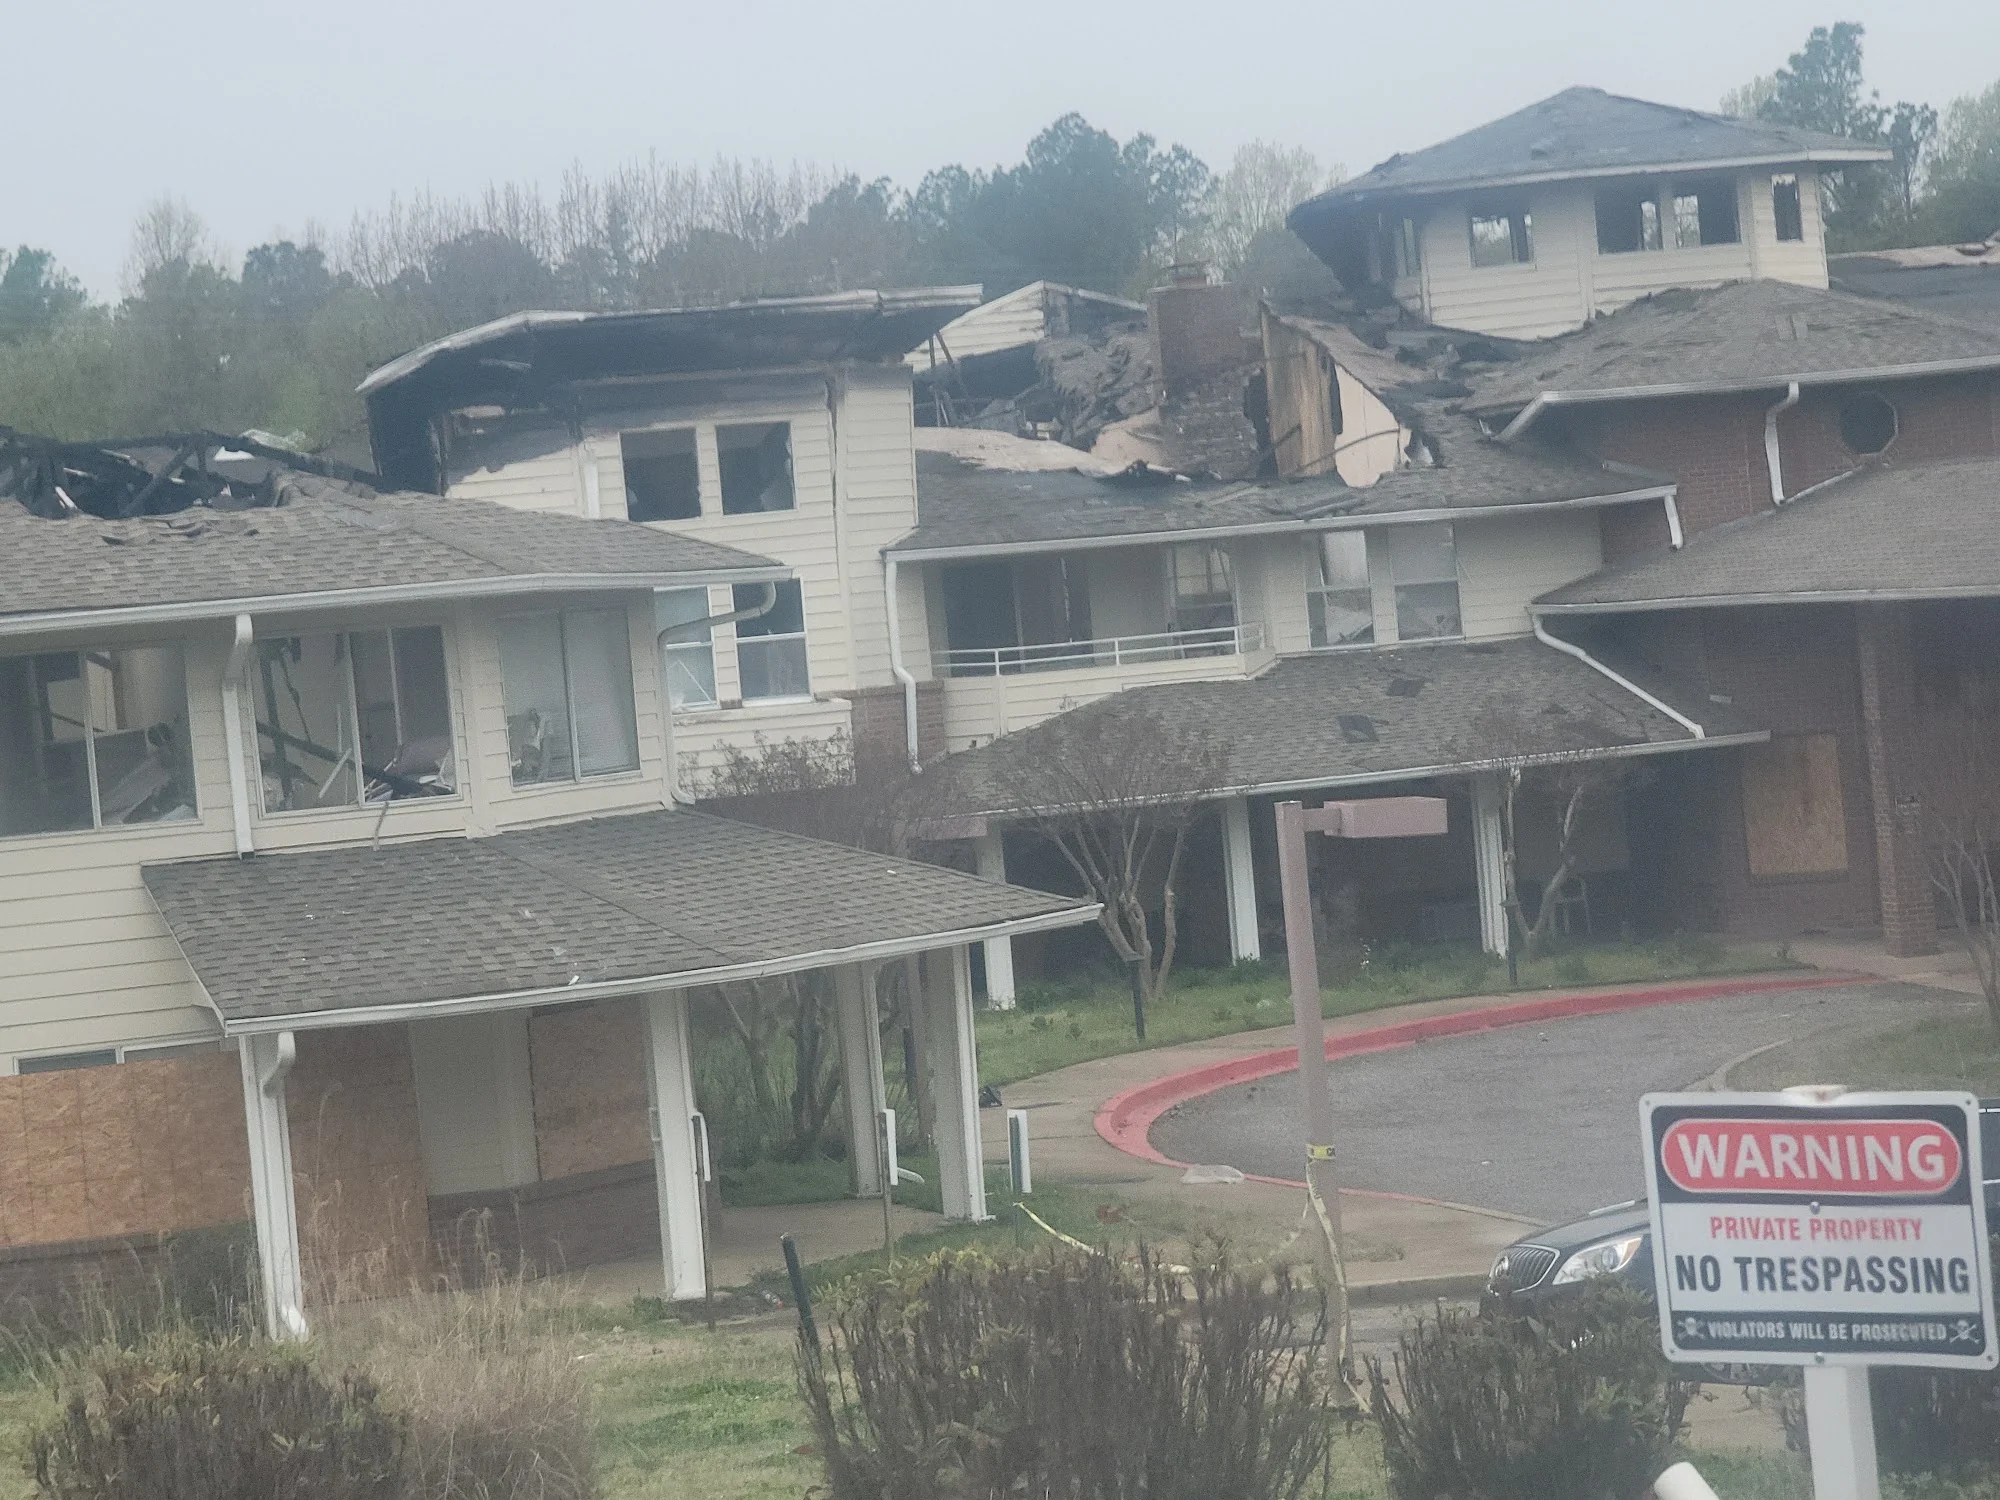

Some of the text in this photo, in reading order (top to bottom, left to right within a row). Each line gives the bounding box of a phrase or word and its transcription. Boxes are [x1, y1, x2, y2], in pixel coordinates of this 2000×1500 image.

[1677, 1134, 1945, 1181] WARNING
[1710, 1216, 1922, 1241] PRIVATE PROPERTY
[1675, 1255, 1970, 1294] NO TRESPASSING
[1707, 1321, 1947, 1342] VIOLATORS WILL BE PROSECUTED
